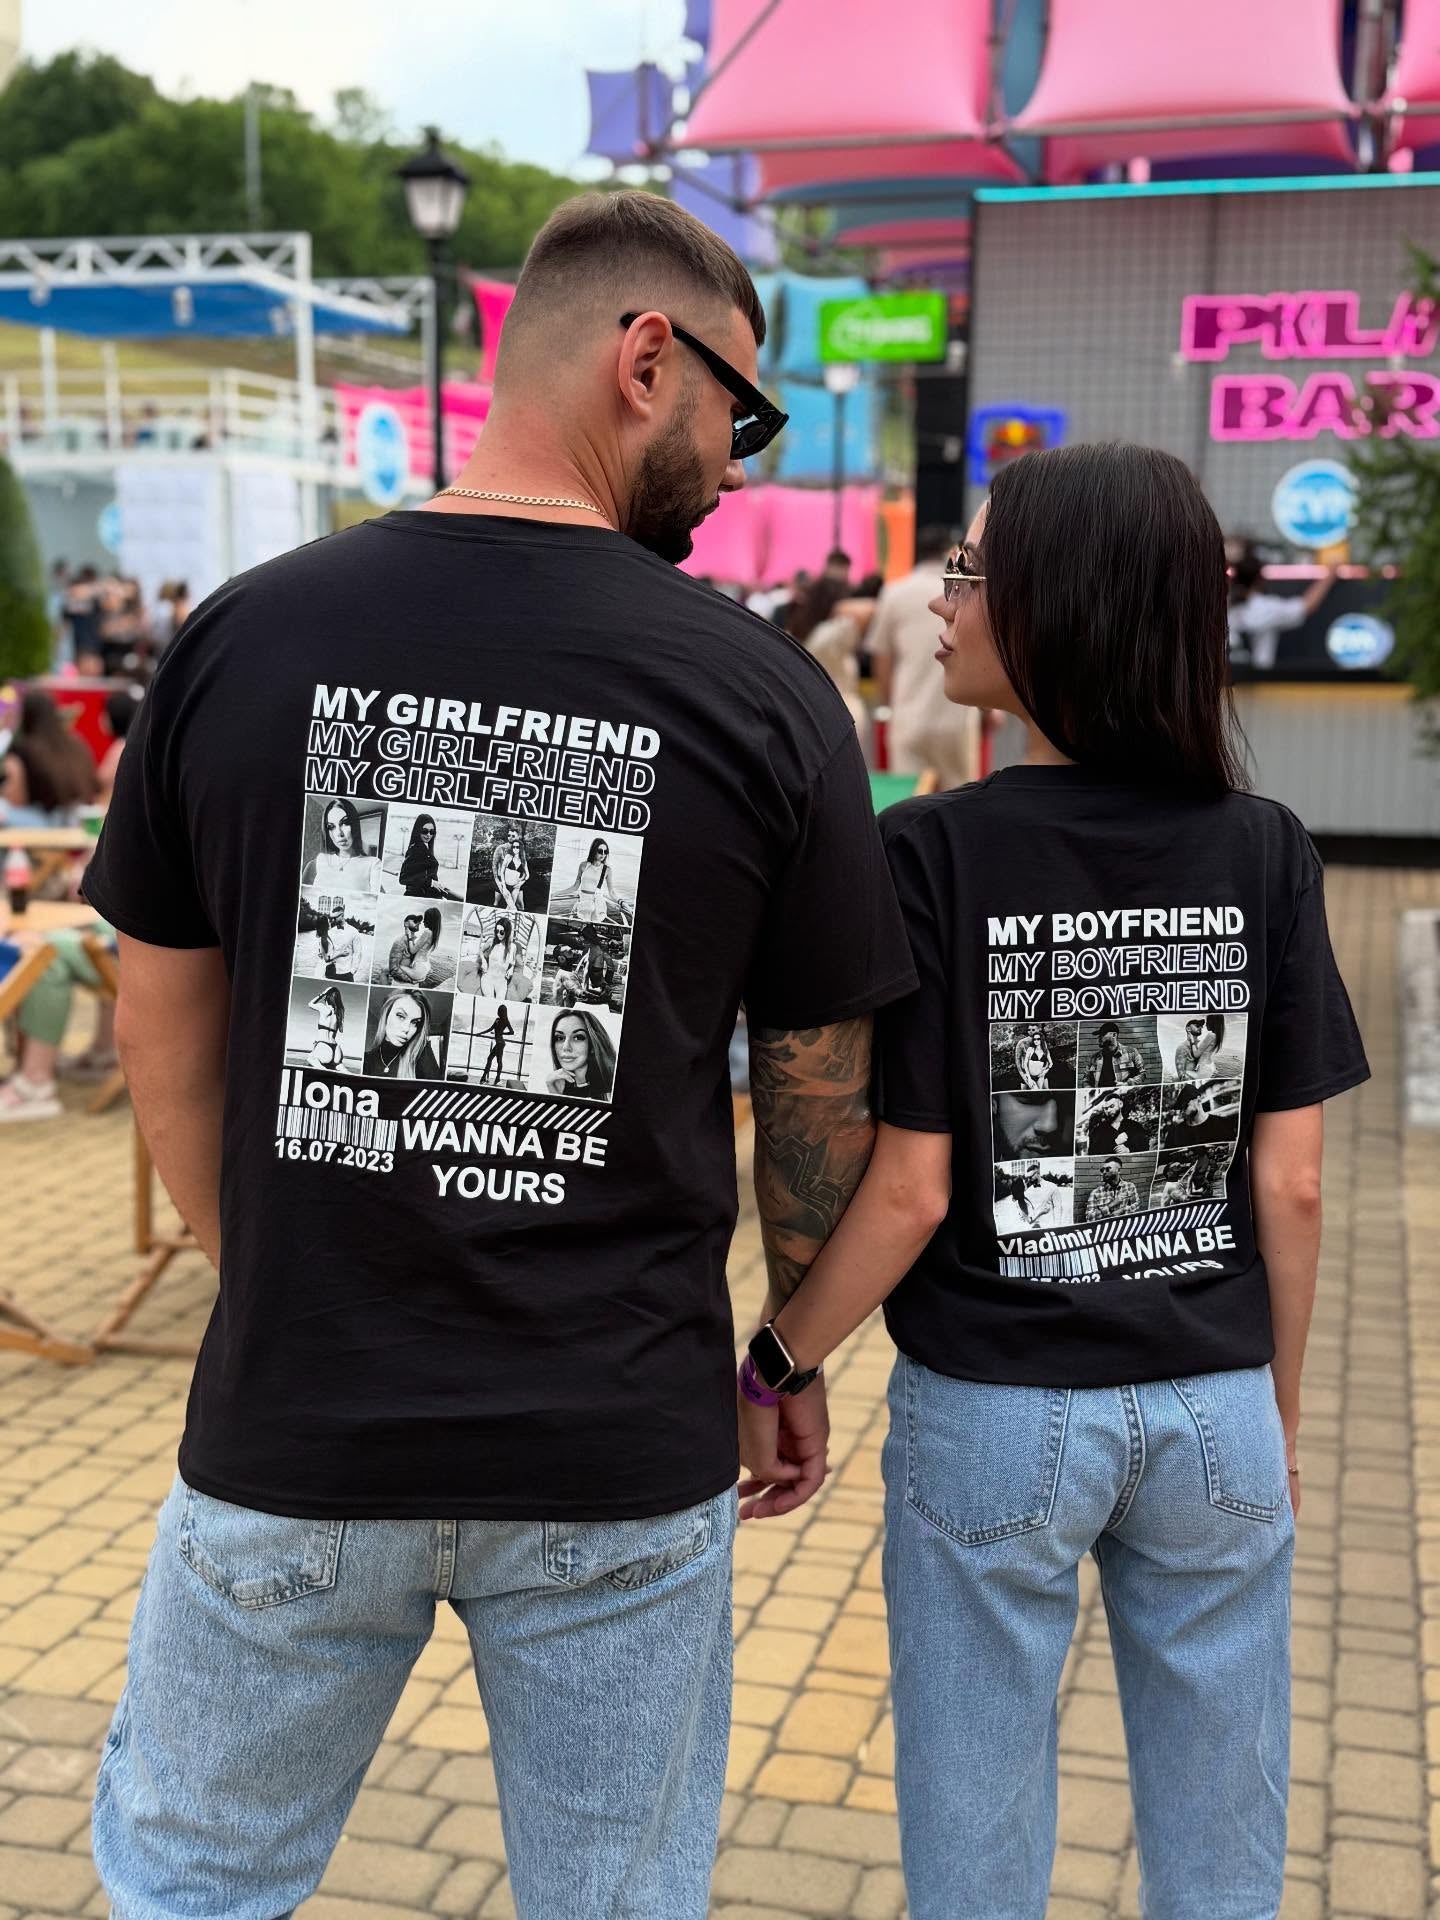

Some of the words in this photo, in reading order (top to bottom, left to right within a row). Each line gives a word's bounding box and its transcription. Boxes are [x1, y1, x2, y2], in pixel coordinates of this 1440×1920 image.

[1210, 371, 1440, 442] BAR
[312, 684, 381, 721] MY
[386, 693, 661, 760] GIRLFRIEND
[307, 719, 374, 757] MY
[377, 726, 656, 796] GIRLFRIEND
[304, 756, 371, 795] MY
[372, 764, 651, 832] GIRLFRIEND
[987, 914, 1044, 945] MY
[1052, 906, 1245, 943] BOYFRIEND
[988, 951, 1046, 983] MY
[1051, 942, 1248, 981] BOYFRIEND
[987, 989, 1046, 1020] MY
[1051, 979, 1251, 1018] BOYFRIEND
[278, 1068, 380, 1118] Ilona
[273, 1137, 395, 1173] 16.07.2023
[402, 1119, 545, 1160] WANNA
[554, 1131, 609, 1167] BE
[431, 1164, 566, 1204] YOURS
[997, 1228, 1093, 1255] Vladimir
[1094, 1230, 1192, 1269] WANNA
[1195, 1224, 1237, 1252] BE
